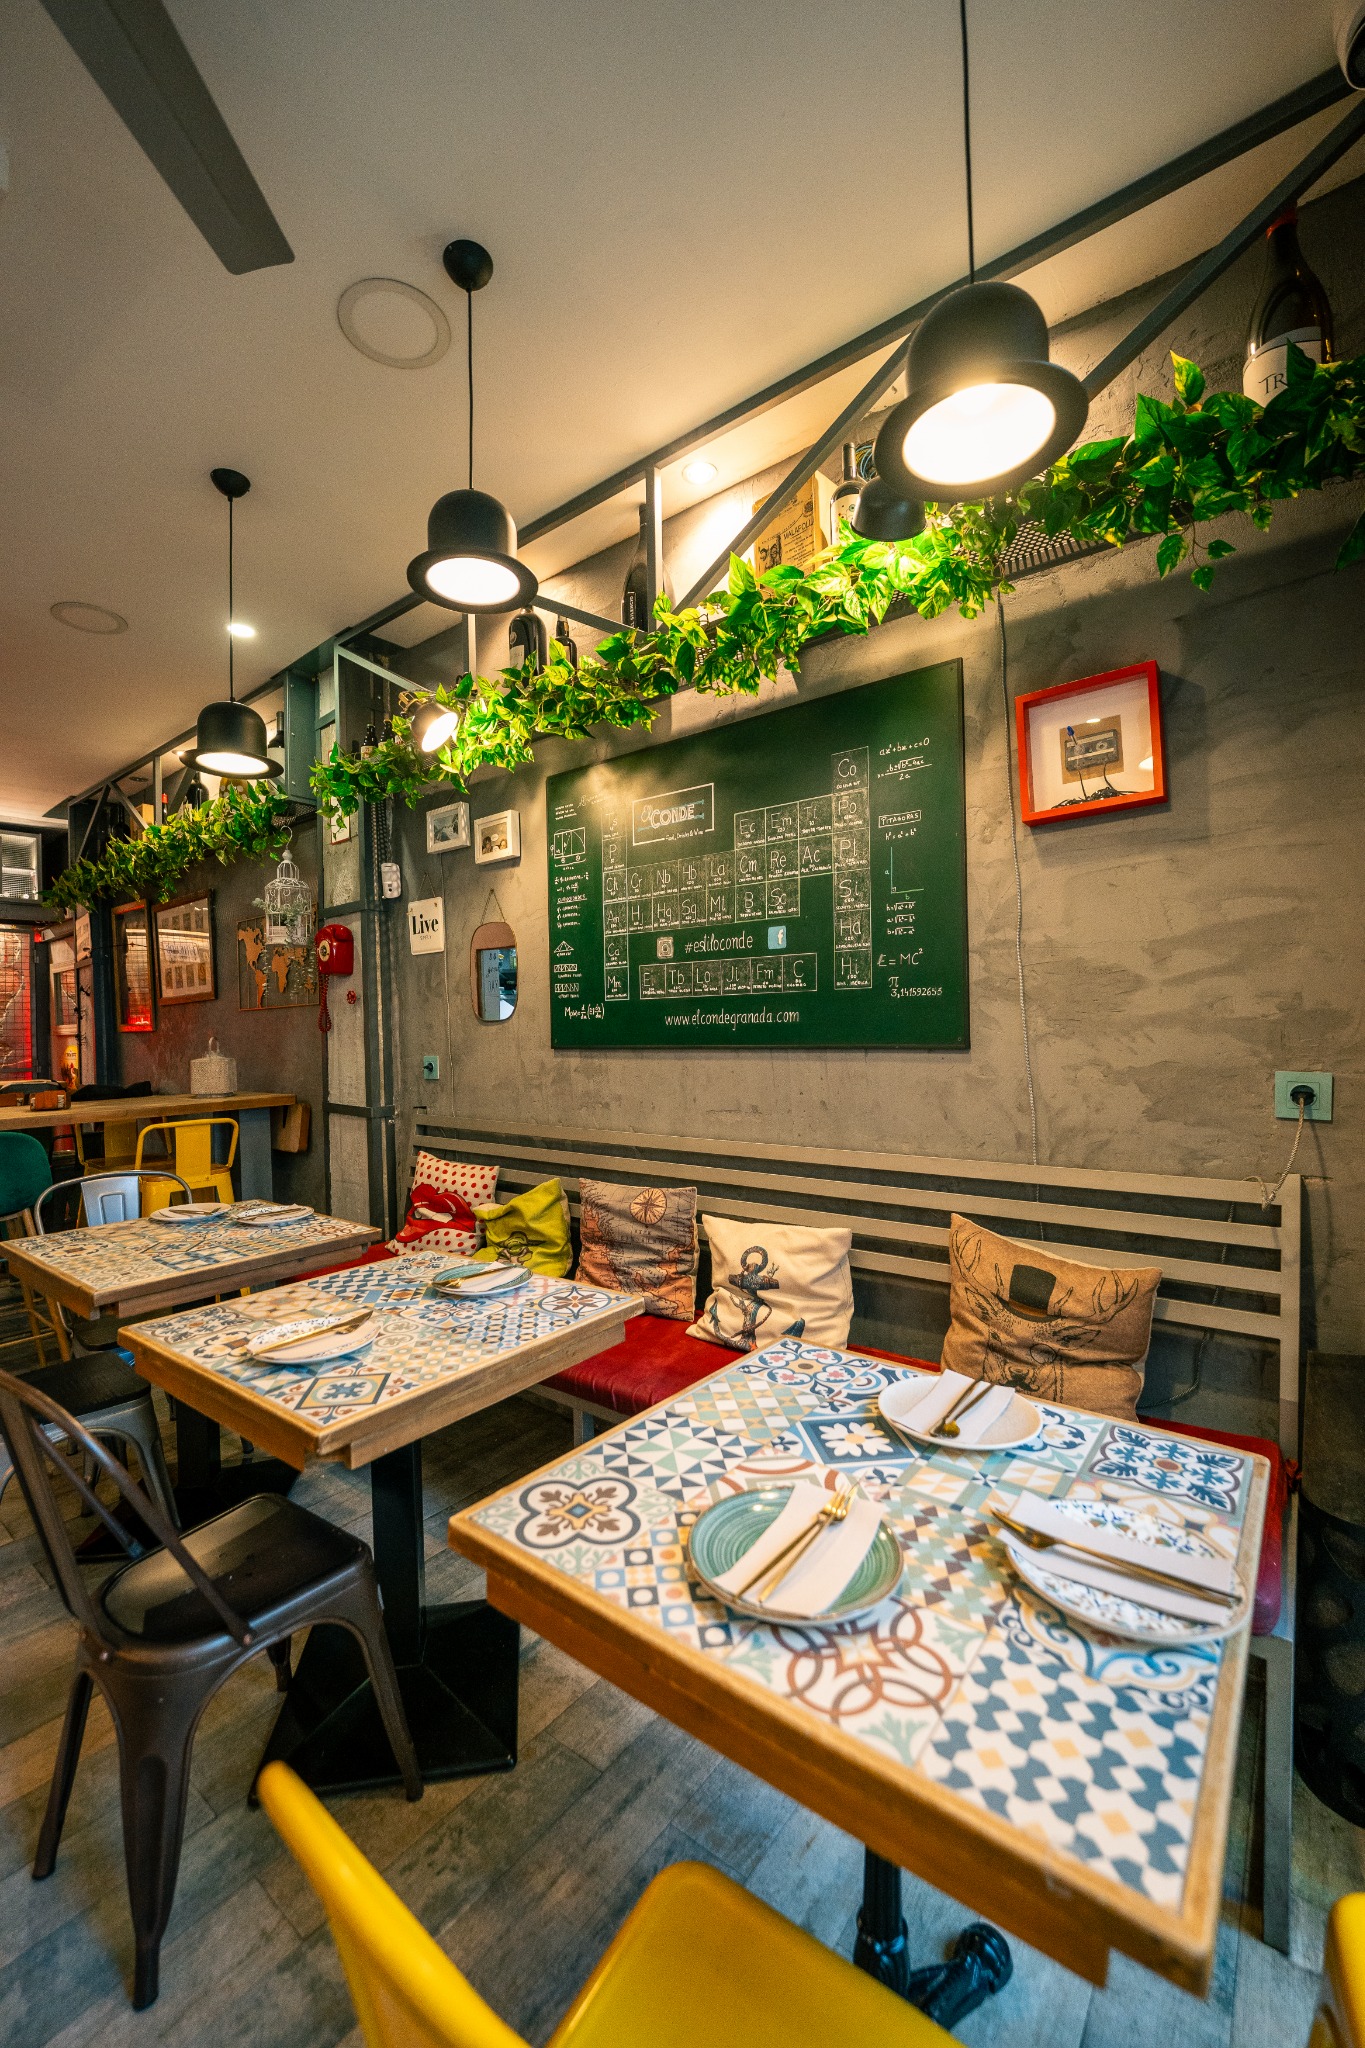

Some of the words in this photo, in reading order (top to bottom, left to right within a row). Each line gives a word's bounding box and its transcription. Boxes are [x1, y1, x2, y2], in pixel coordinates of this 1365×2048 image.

[837, 758, 857, 778] Co
[650, 804, 695, 829] CONDE
[839, 879, 859, 898] Si
[744, 891, 754, 909] B
[412, 913, 439, 935] Live
[685, 931, 754, 954] #estiloconde
[669, 969, 685, 985] Tb
[696, 967, 711, 984] Lo
[756, 963, 774, 980] Fm
[793, 960, 805, 978] C
[665, 1006, 800, 1031] www.elcondegranada.com
